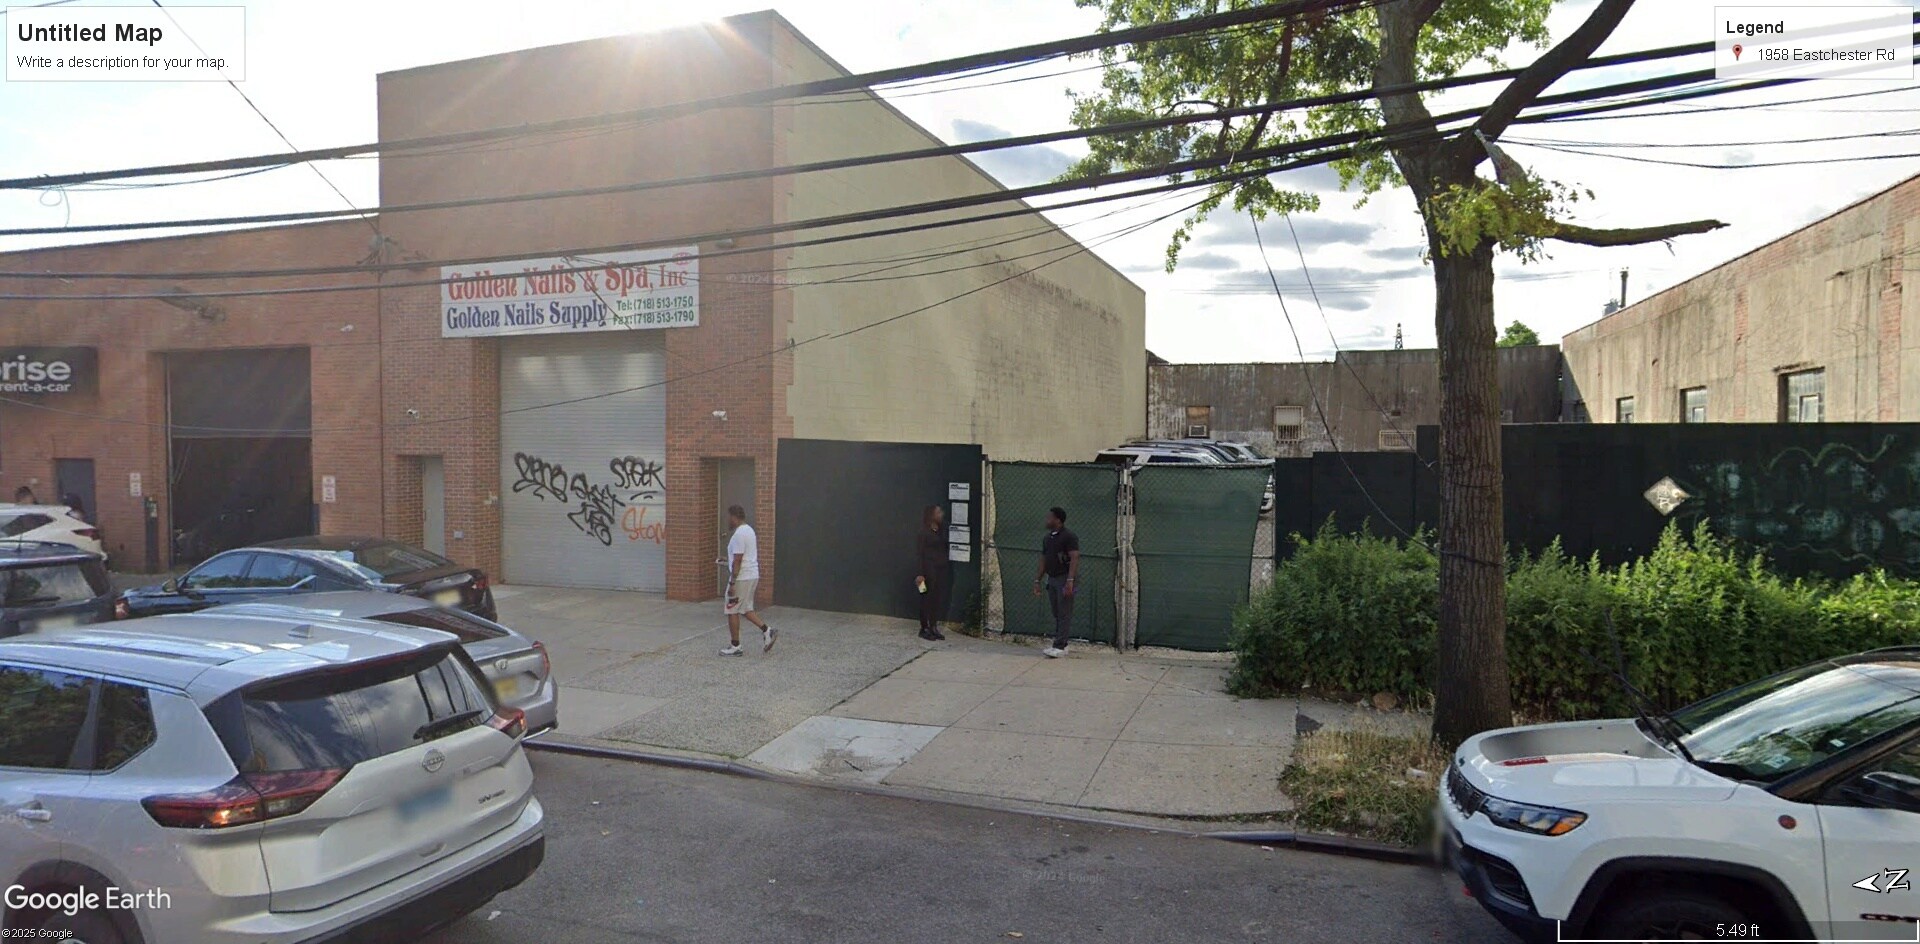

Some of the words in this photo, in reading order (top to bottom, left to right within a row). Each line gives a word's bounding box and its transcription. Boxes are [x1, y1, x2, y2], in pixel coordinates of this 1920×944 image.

[448, 269, 517, 300] Golden
[523, 264, 576, 296] Nails
[583, 266, 598, 292] &
[605, 260, 654, 297] Spa,
[660, 264, 689, 287] Inc
[447, 306, 500, 330] Golden
[504, 302, 545, 326] Nails
[549, 298, 607, 329] Supply
[656, 295, 694, 309] 513-1750
[656, 310, 695, 324] 513-1790
[0, 354, 71, 381] rise
